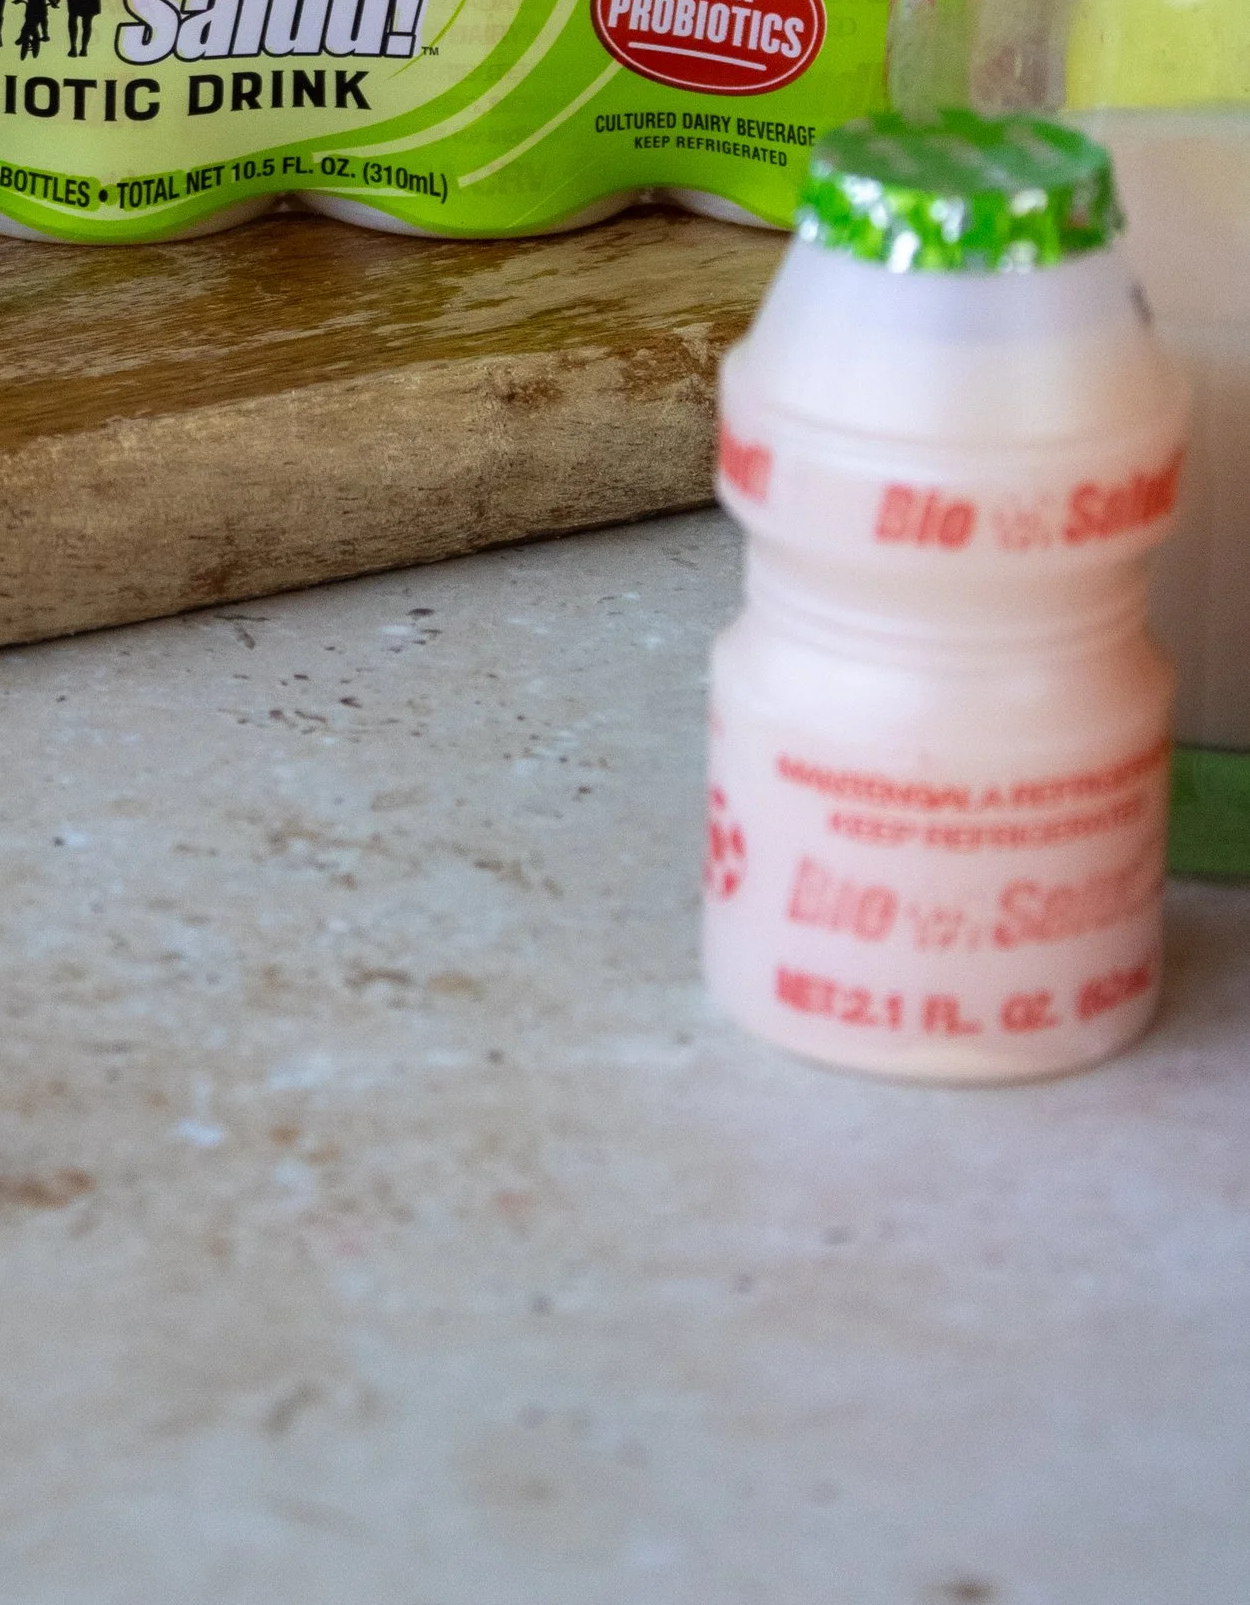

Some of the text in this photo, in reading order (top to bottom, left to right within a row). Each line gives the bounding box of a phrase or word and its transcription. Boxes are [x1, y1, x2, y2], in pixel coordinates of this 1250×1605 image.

[187, 70, 373, 118] DRINK
[594, 110, 816, 147] CULTURED DAIRY BEVERAGE
[634, 134, 788, 168] KEEP REFRIGERATED
[0, 166, 92, 208] BOTTLES
[116, 176, 181, 209] TOTAL
[186, 163, 223, 196] NET
[231, 157, 277, 182] 10.5
[282, 156, 314, 176] FL.
[321, 156, 356, 179] OZ.
[362, 159, 450, 205] (310mL)
